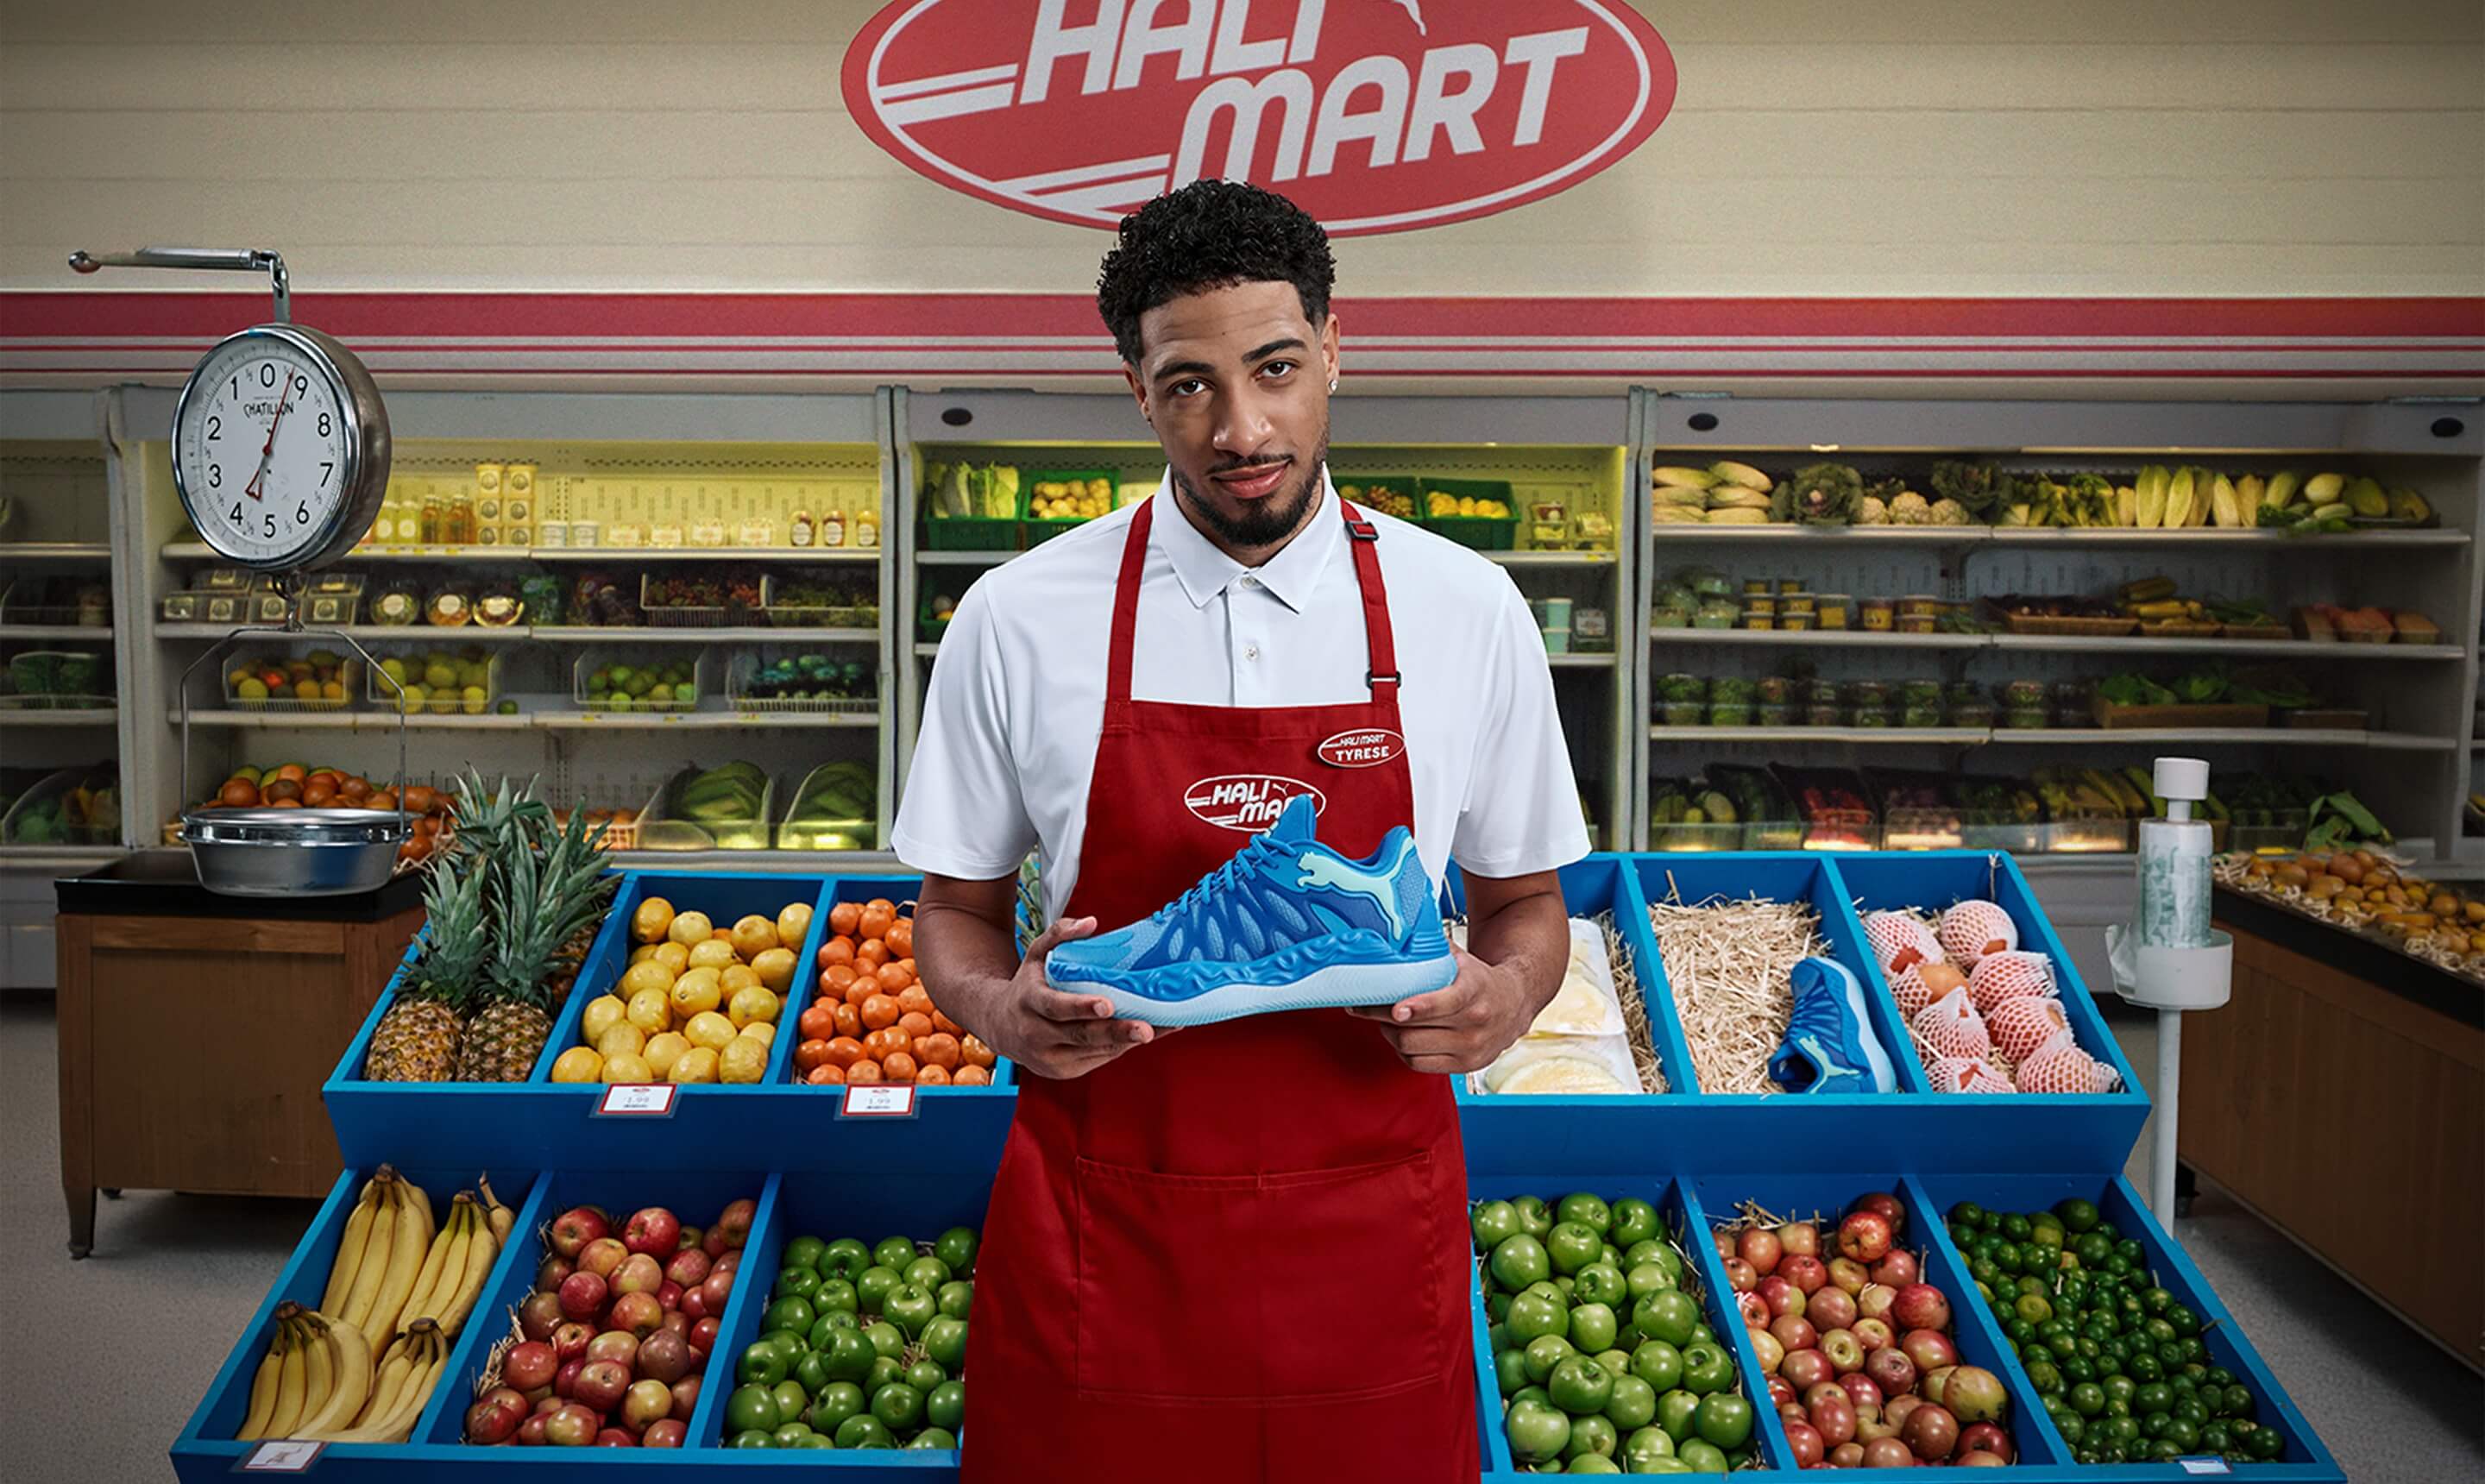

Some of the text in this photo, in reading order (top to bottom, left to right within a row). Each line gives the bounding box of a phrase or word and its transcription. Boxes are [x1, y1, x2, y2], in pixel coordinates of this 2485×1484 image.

[1171, 26, 1590, 194] MART
[261, 363, 275, 387] 0
[230, 375, 237, 401] 1
[294, 375, 308, 401] 9
[207, 416, 222, 441] 2
[318, 412, 331, 437] 8
[208, 463, 222, 488] 3
[319, 462, 333, 487] 7
[230, 501, 243, 525] 4
[296, 500, 310, 525] 6
[263, 513, 276, 538] 5
[1335, 745, 1390, 762] TYRESE
[1211, 779, 1271, 806] HALI
[1238, 793, 1316, 823] MA
